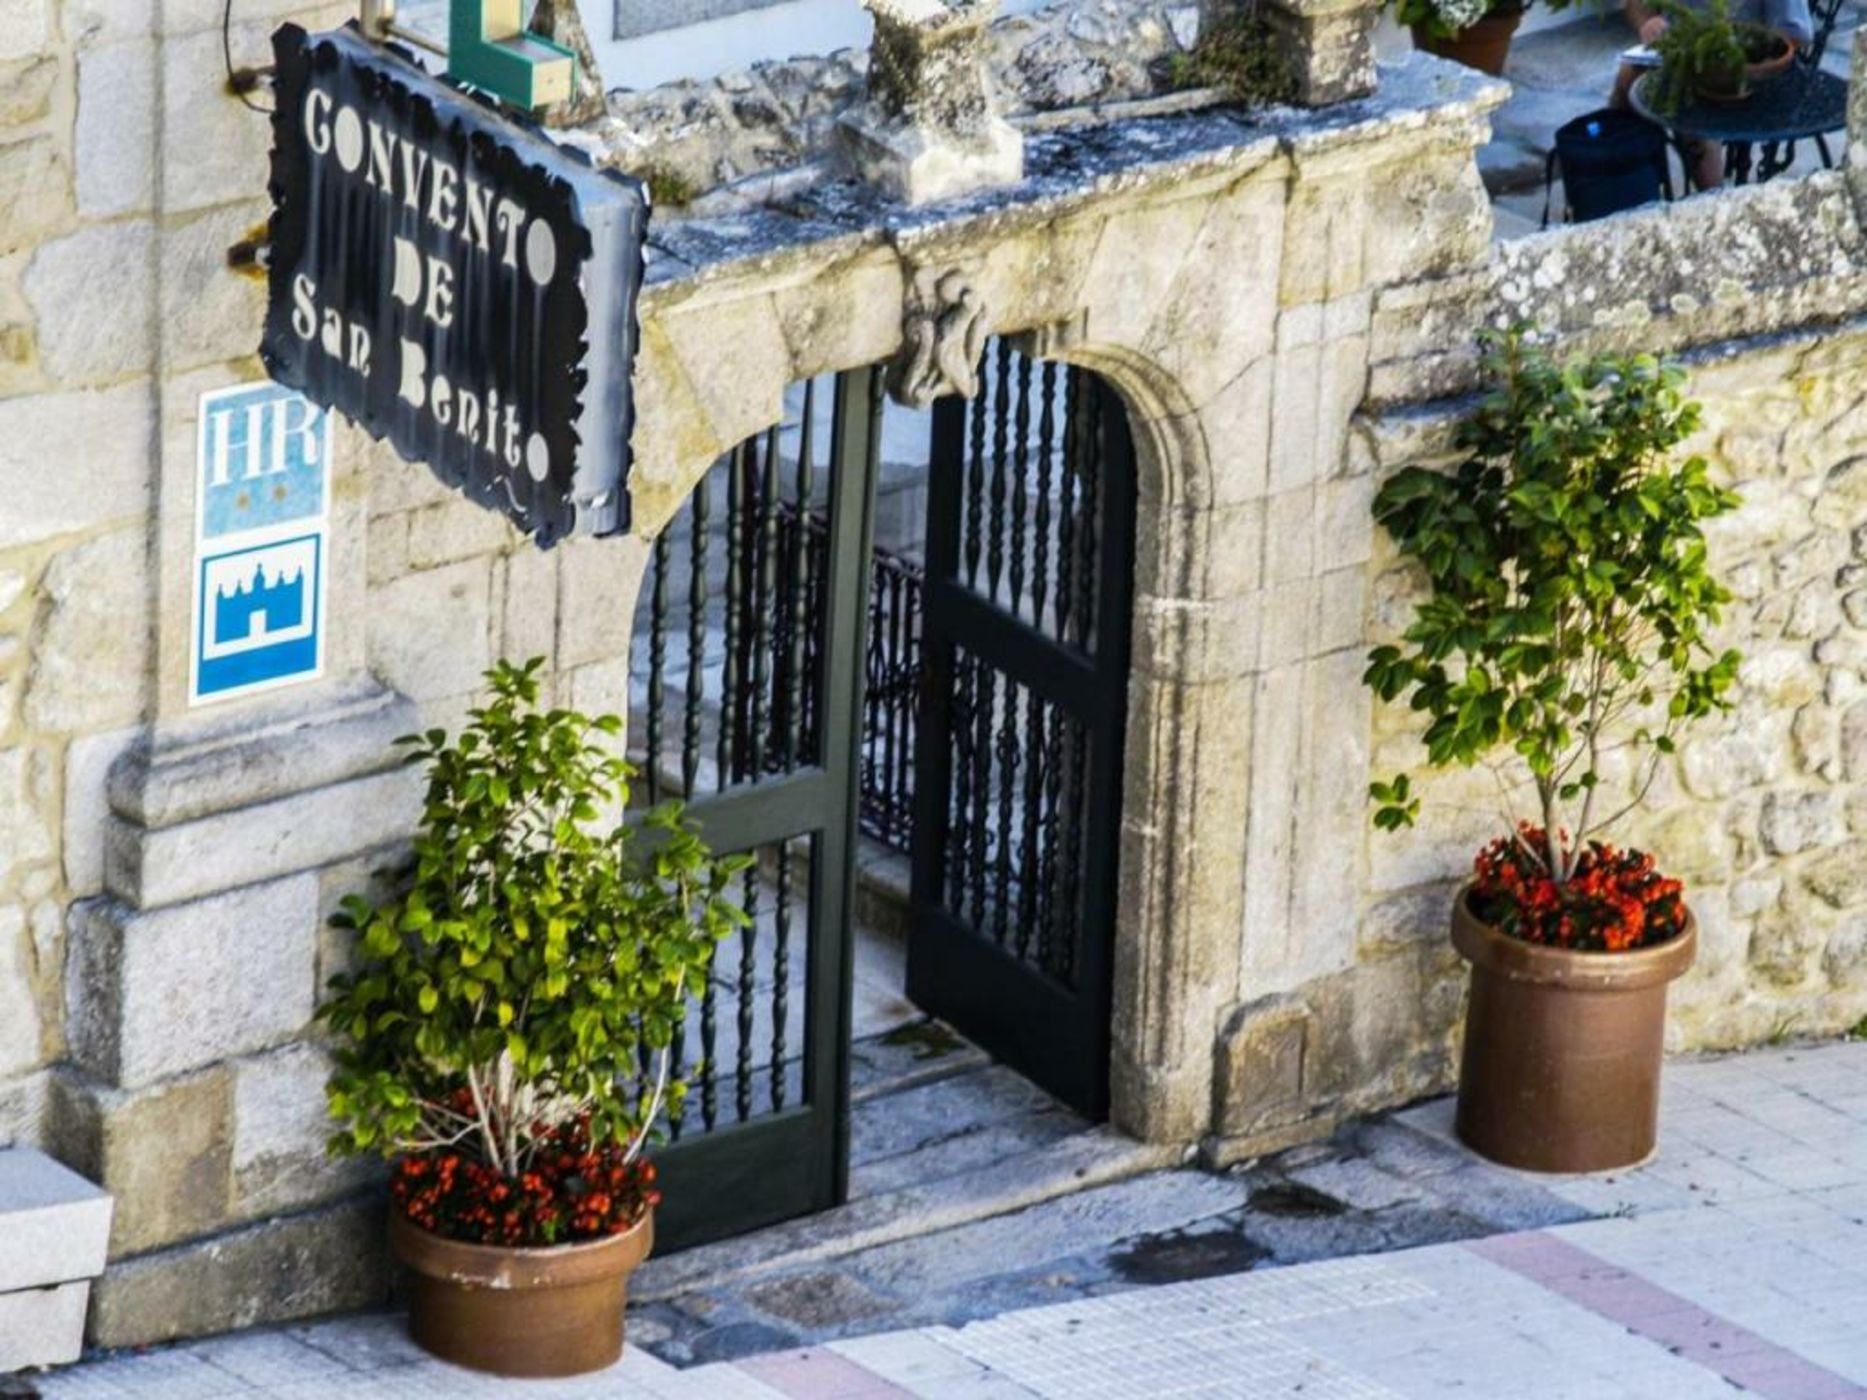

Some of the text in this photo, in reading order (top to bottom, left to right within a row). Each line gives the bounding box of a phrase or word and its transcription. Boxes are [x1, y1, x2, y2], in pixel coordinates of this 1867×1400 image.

[305, 87, 556, 286] CONVENTO
[392, 234, 454, 328] DE
[209, 397, 320, 487] HR
[292, 273, 550, 482] San Benito
